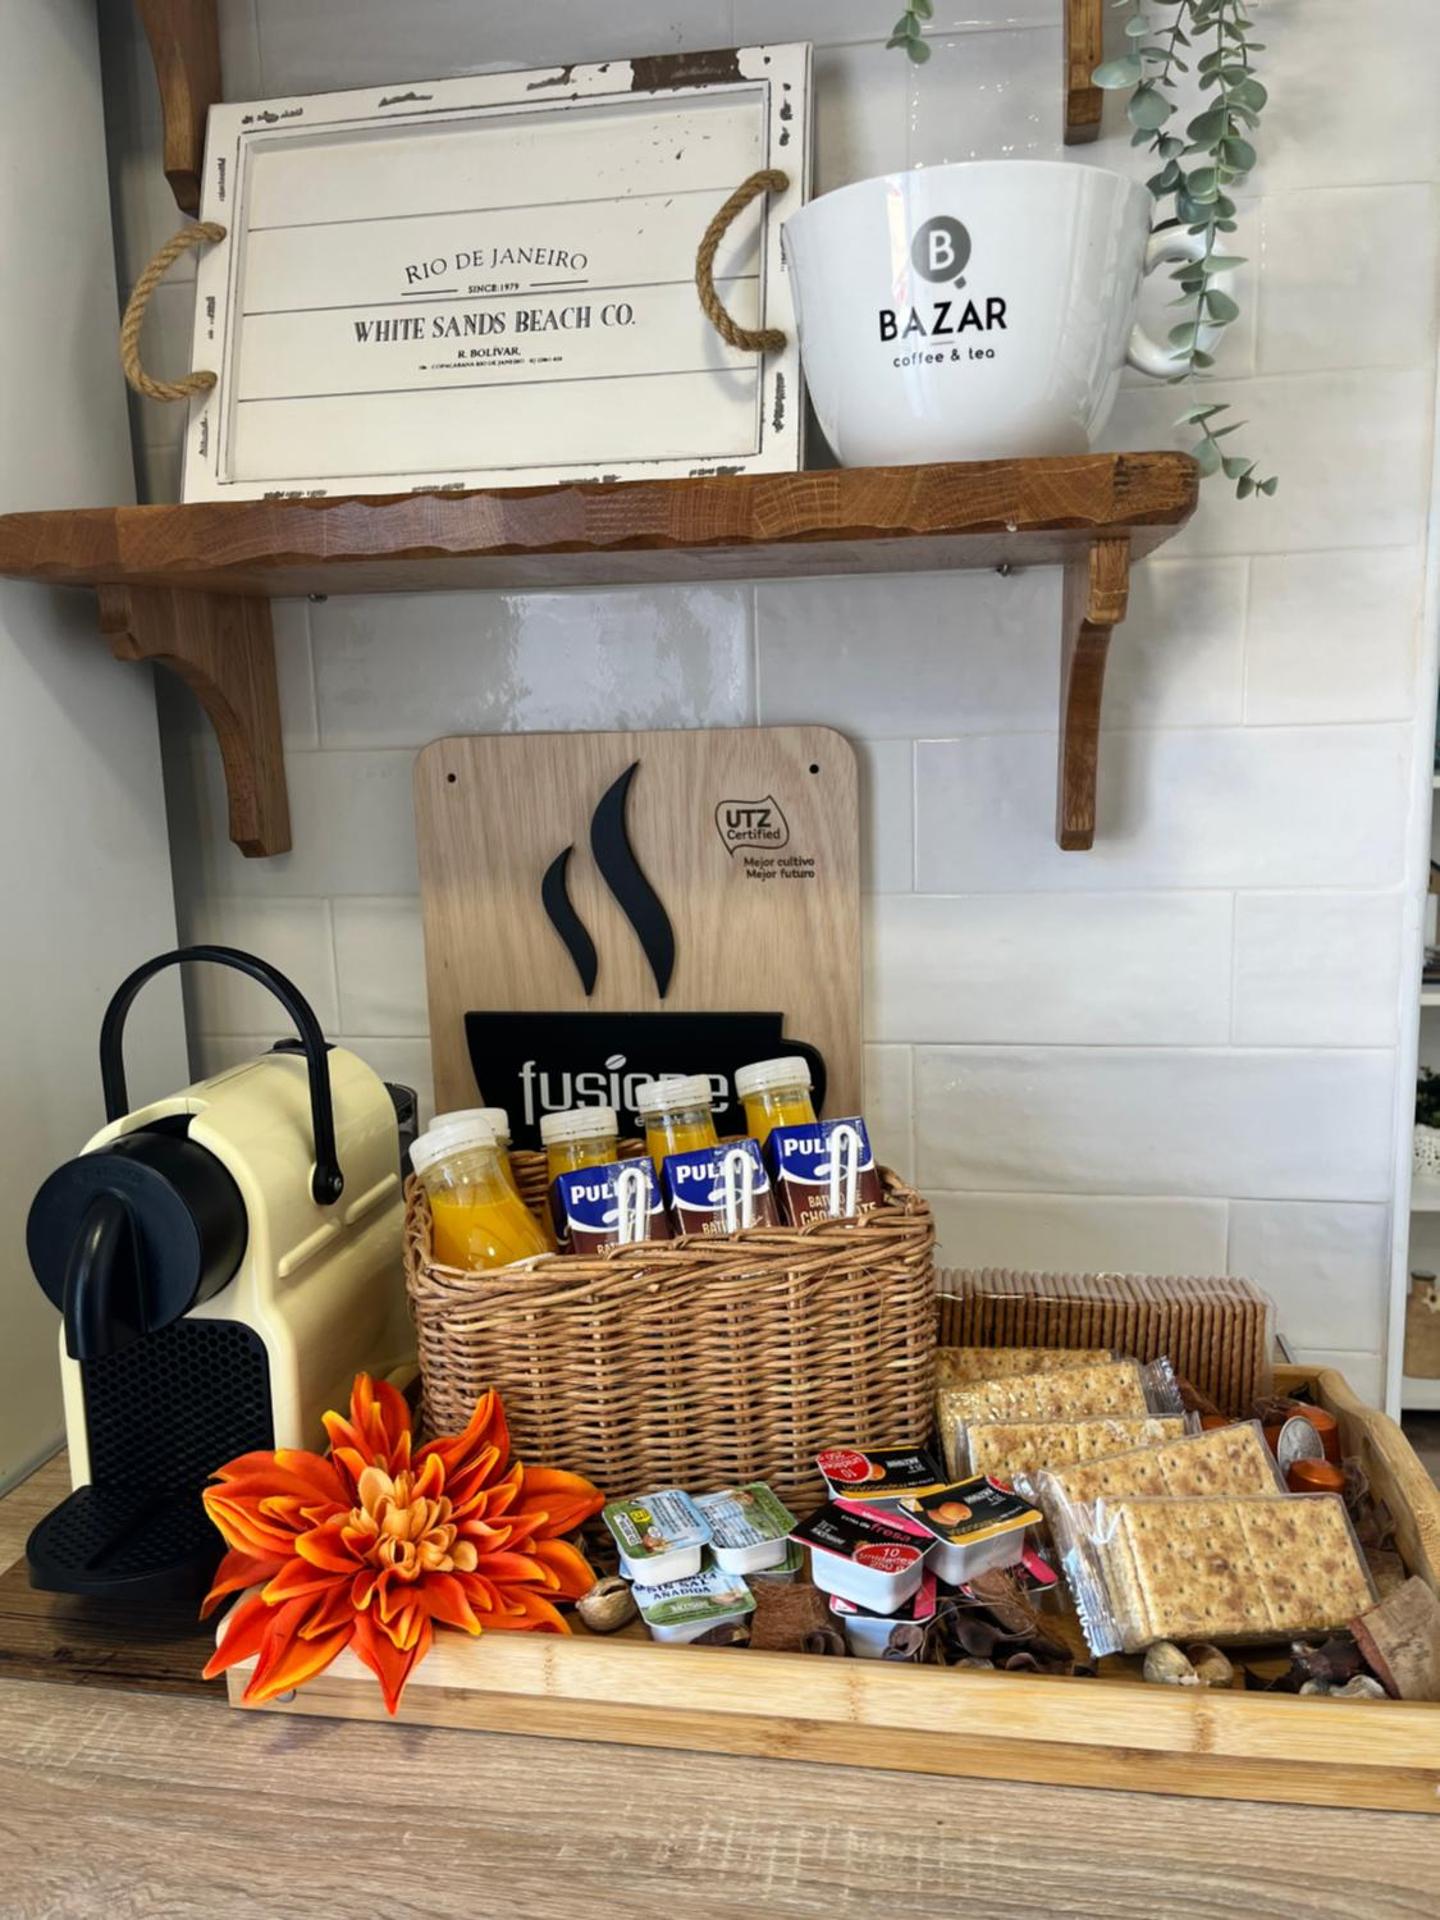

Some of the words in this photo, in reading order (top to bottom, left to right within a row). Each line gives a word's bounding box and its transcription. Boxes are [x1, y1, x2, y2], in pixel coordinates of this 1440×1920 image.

[929, 230, 955, 271] B
[405, 259, 447, 284] RIO
[455, 250, 484, 270] DE
[491, 247, 588, 270] JANEIRO
[354, 317, 426, 342] WHITE
[432, 311, 506, 338] SANDS
[514, 306, 592, 333] BEACH
[600, 302, 636, 326] CO.
[879, 297, 1008, 342] BAZAR
[892, 351, 945, 368] coffee
[950, 348, 961, 362] &
[968, 346, 996, 360] tea
[726, 809, 771, 828] UTZ
[727, 828, 781, 840] Certified
[743, 857, 775, 870] Mejor
[777, 856, 815, 867] cultivo
[746, 869, 777, 882] Mejor
[780, 868, 815, 878] futuro
[518, 1054, 729, 1126] fusioe
[869, 1519, 912, 1544] fresa
[883, 1547, 901, 1559] 10
